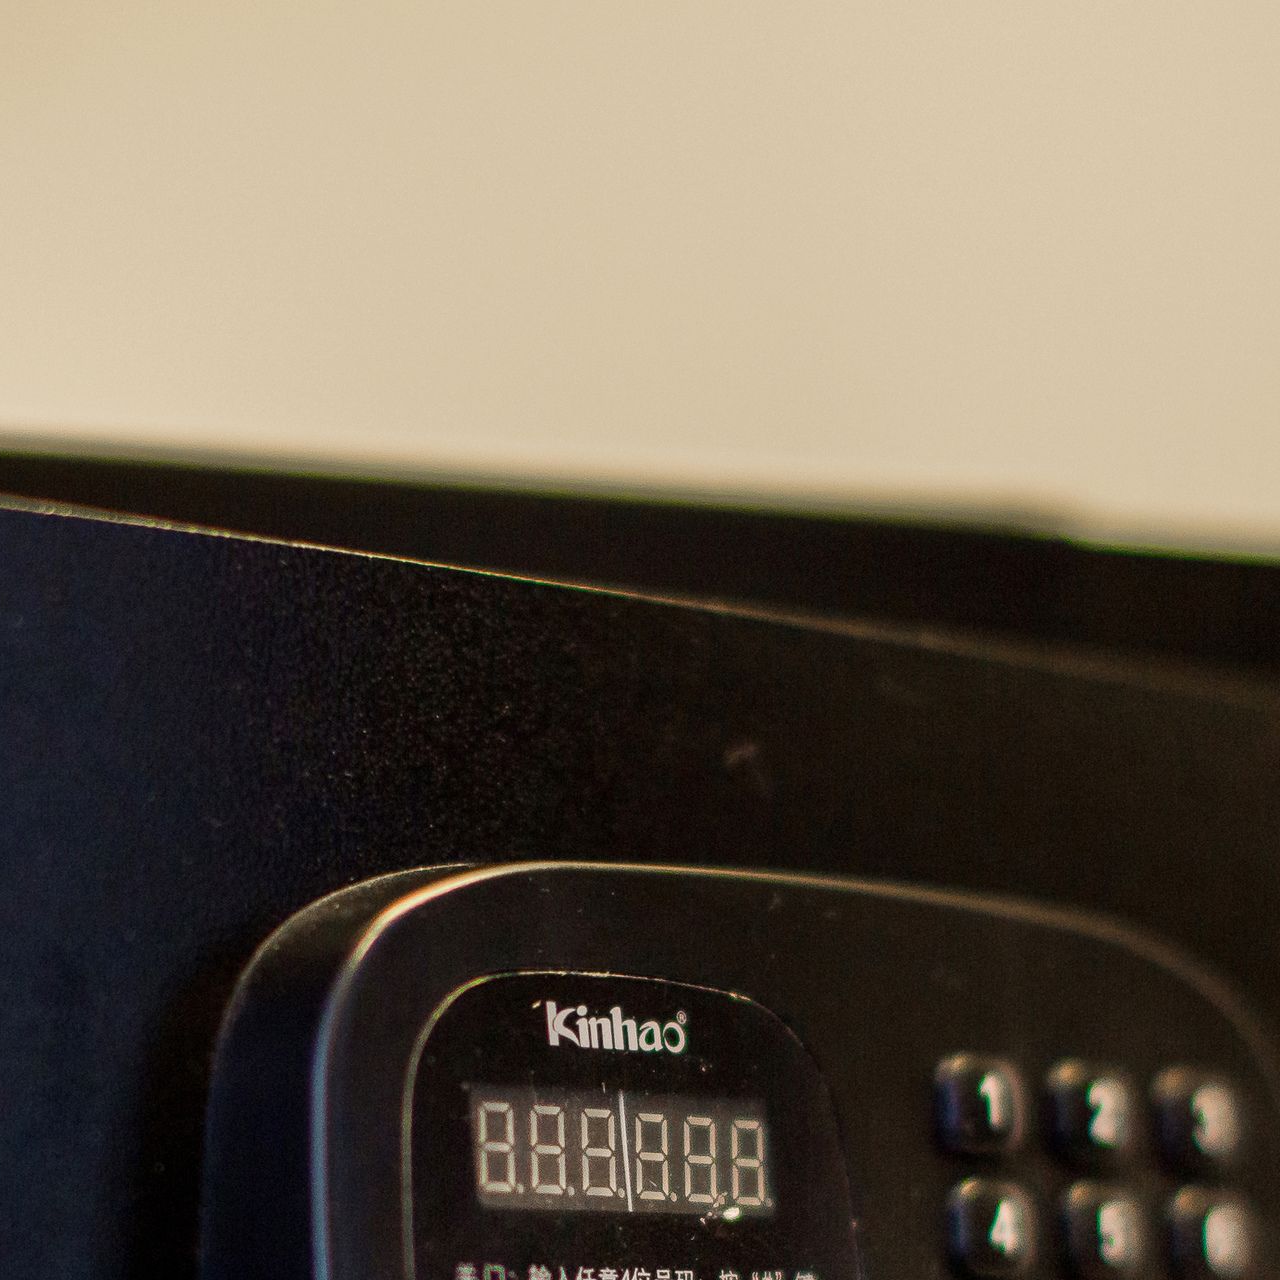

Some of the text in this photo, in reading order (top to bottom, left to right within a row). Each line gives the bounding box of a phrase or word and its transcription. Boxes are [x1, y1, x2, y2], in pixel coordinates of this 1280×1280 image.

[979, 1071, 1007, 1130] 1
[1086, 1077, 1131, 1147] 2
[988, 1199, 1019, 1254] 4
